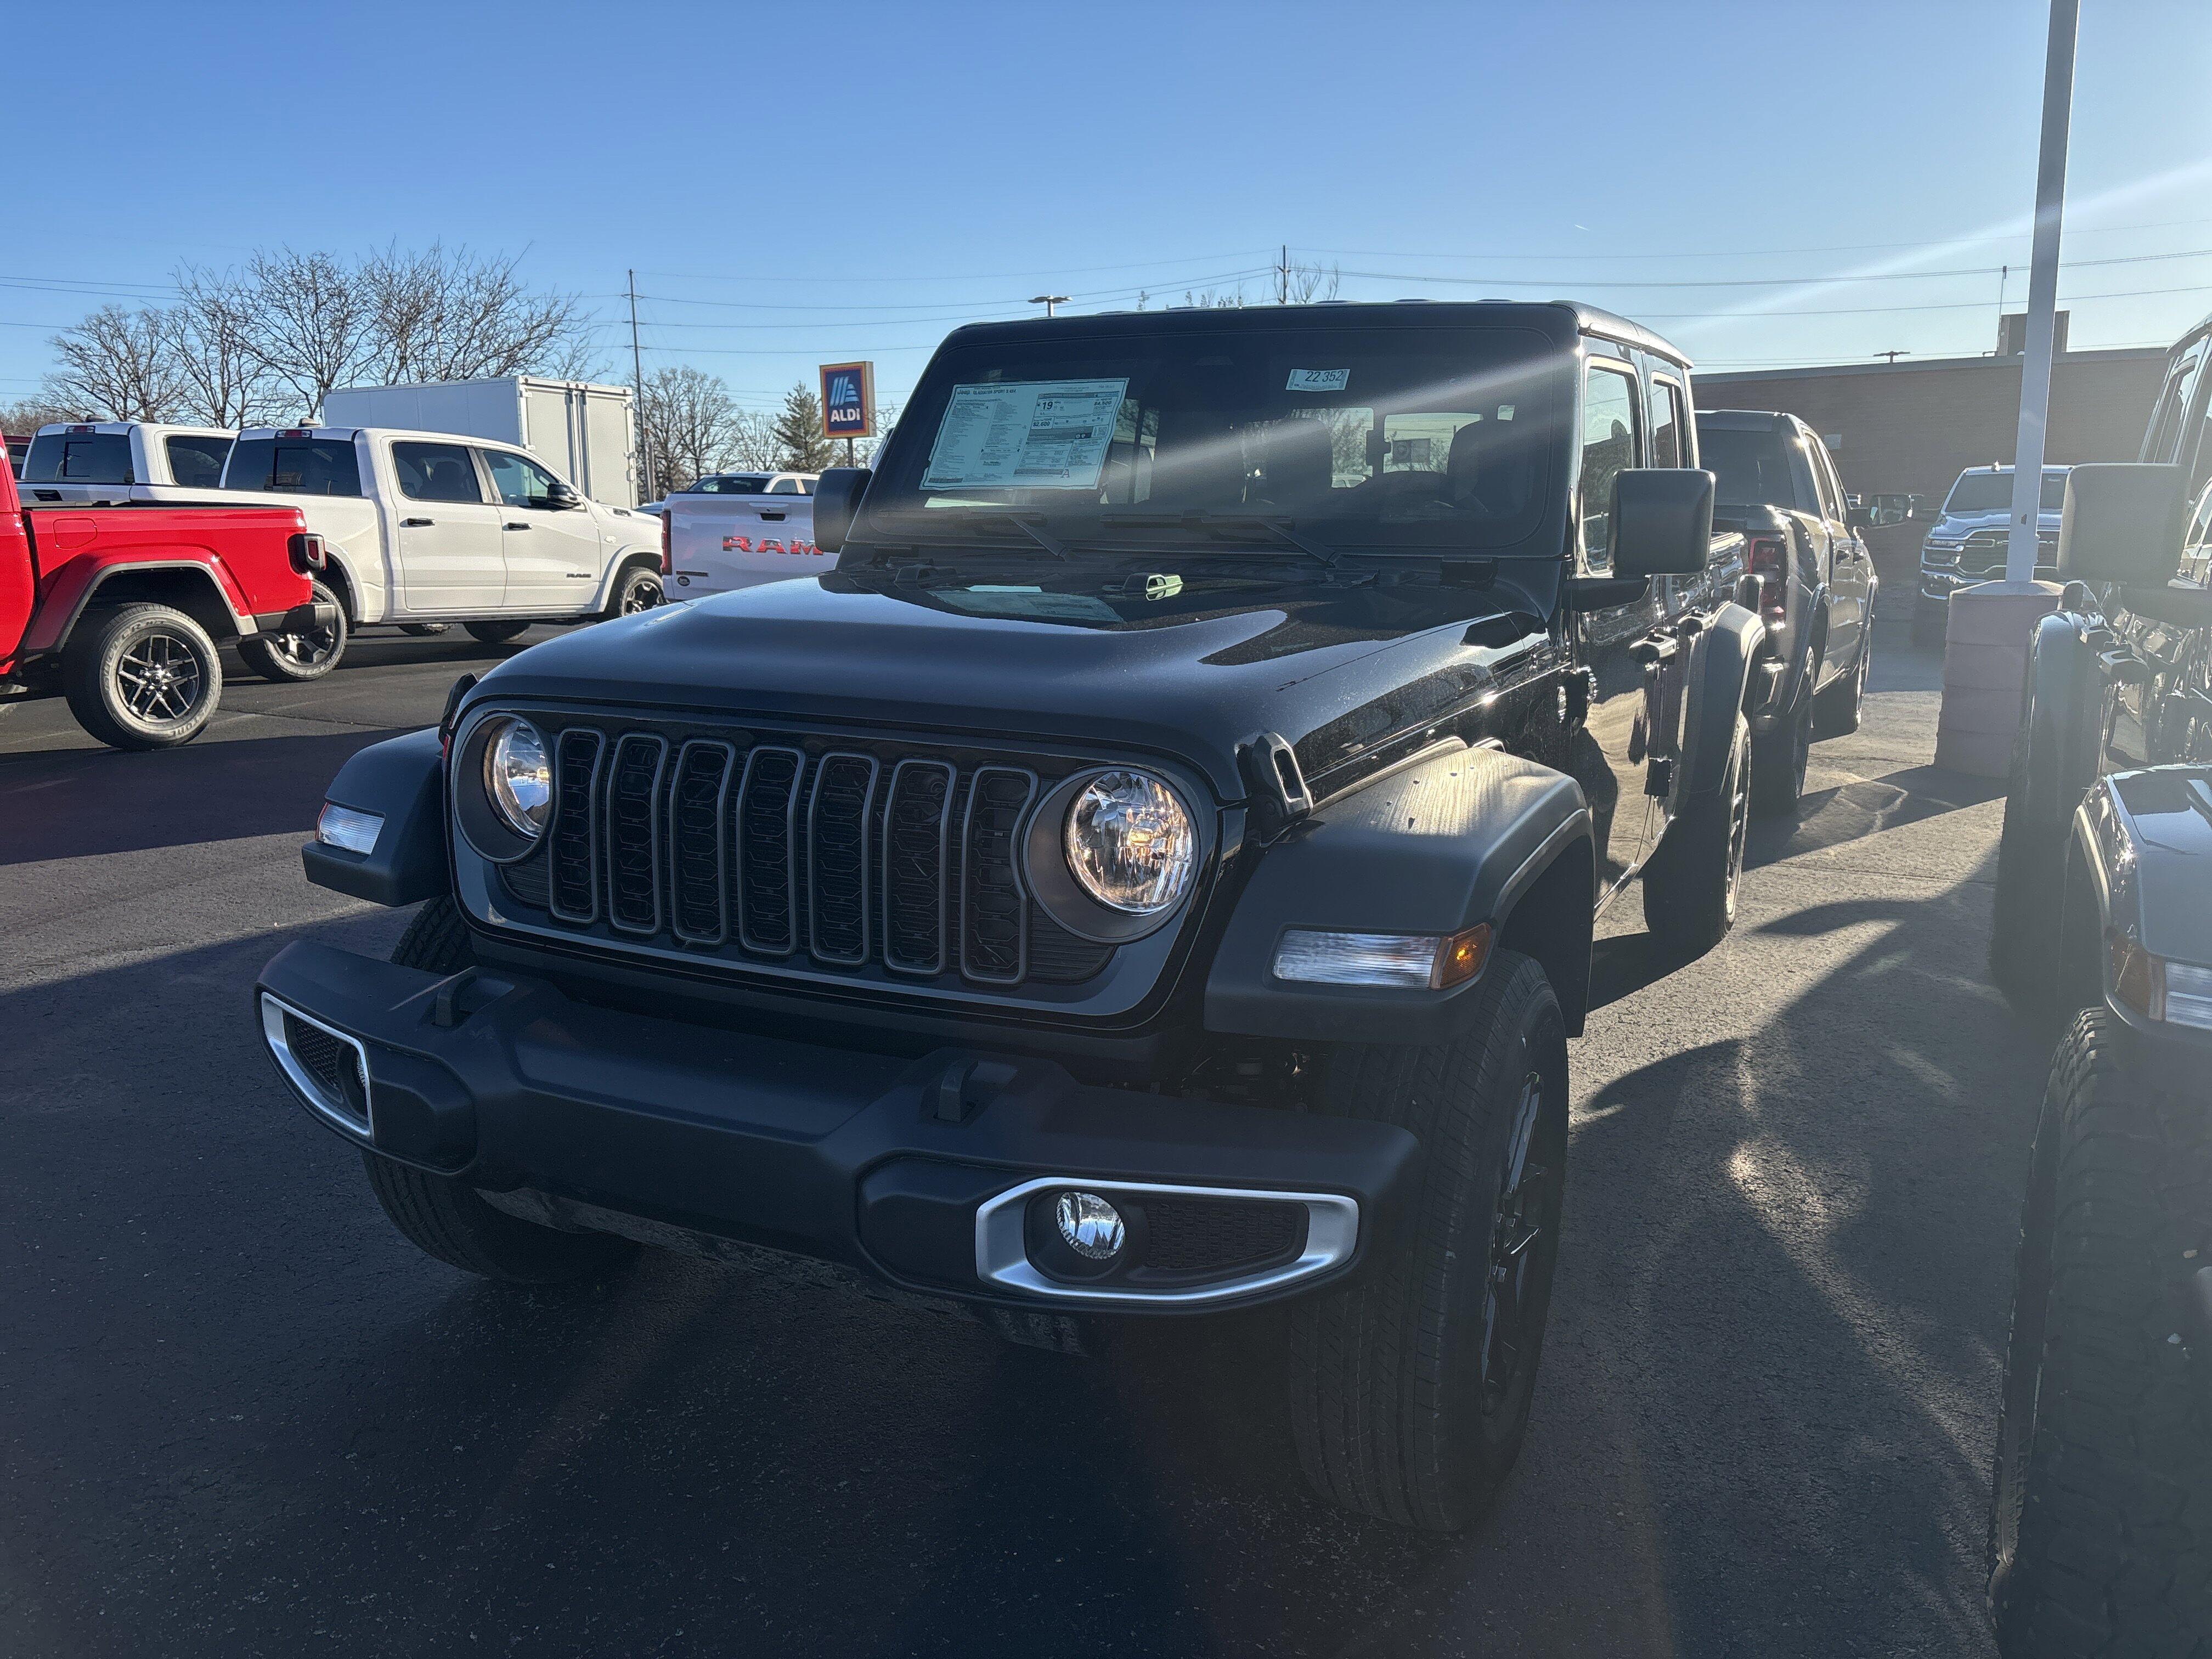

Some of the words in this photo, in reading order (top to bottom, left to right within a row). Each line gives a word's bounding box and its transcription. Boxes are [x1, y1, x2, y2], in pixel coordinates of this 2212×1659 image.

[1042, 401, 1053, 410] 19
[830, 408, 861, 423] ALDI
[722, 535, 824, 556] RAM
